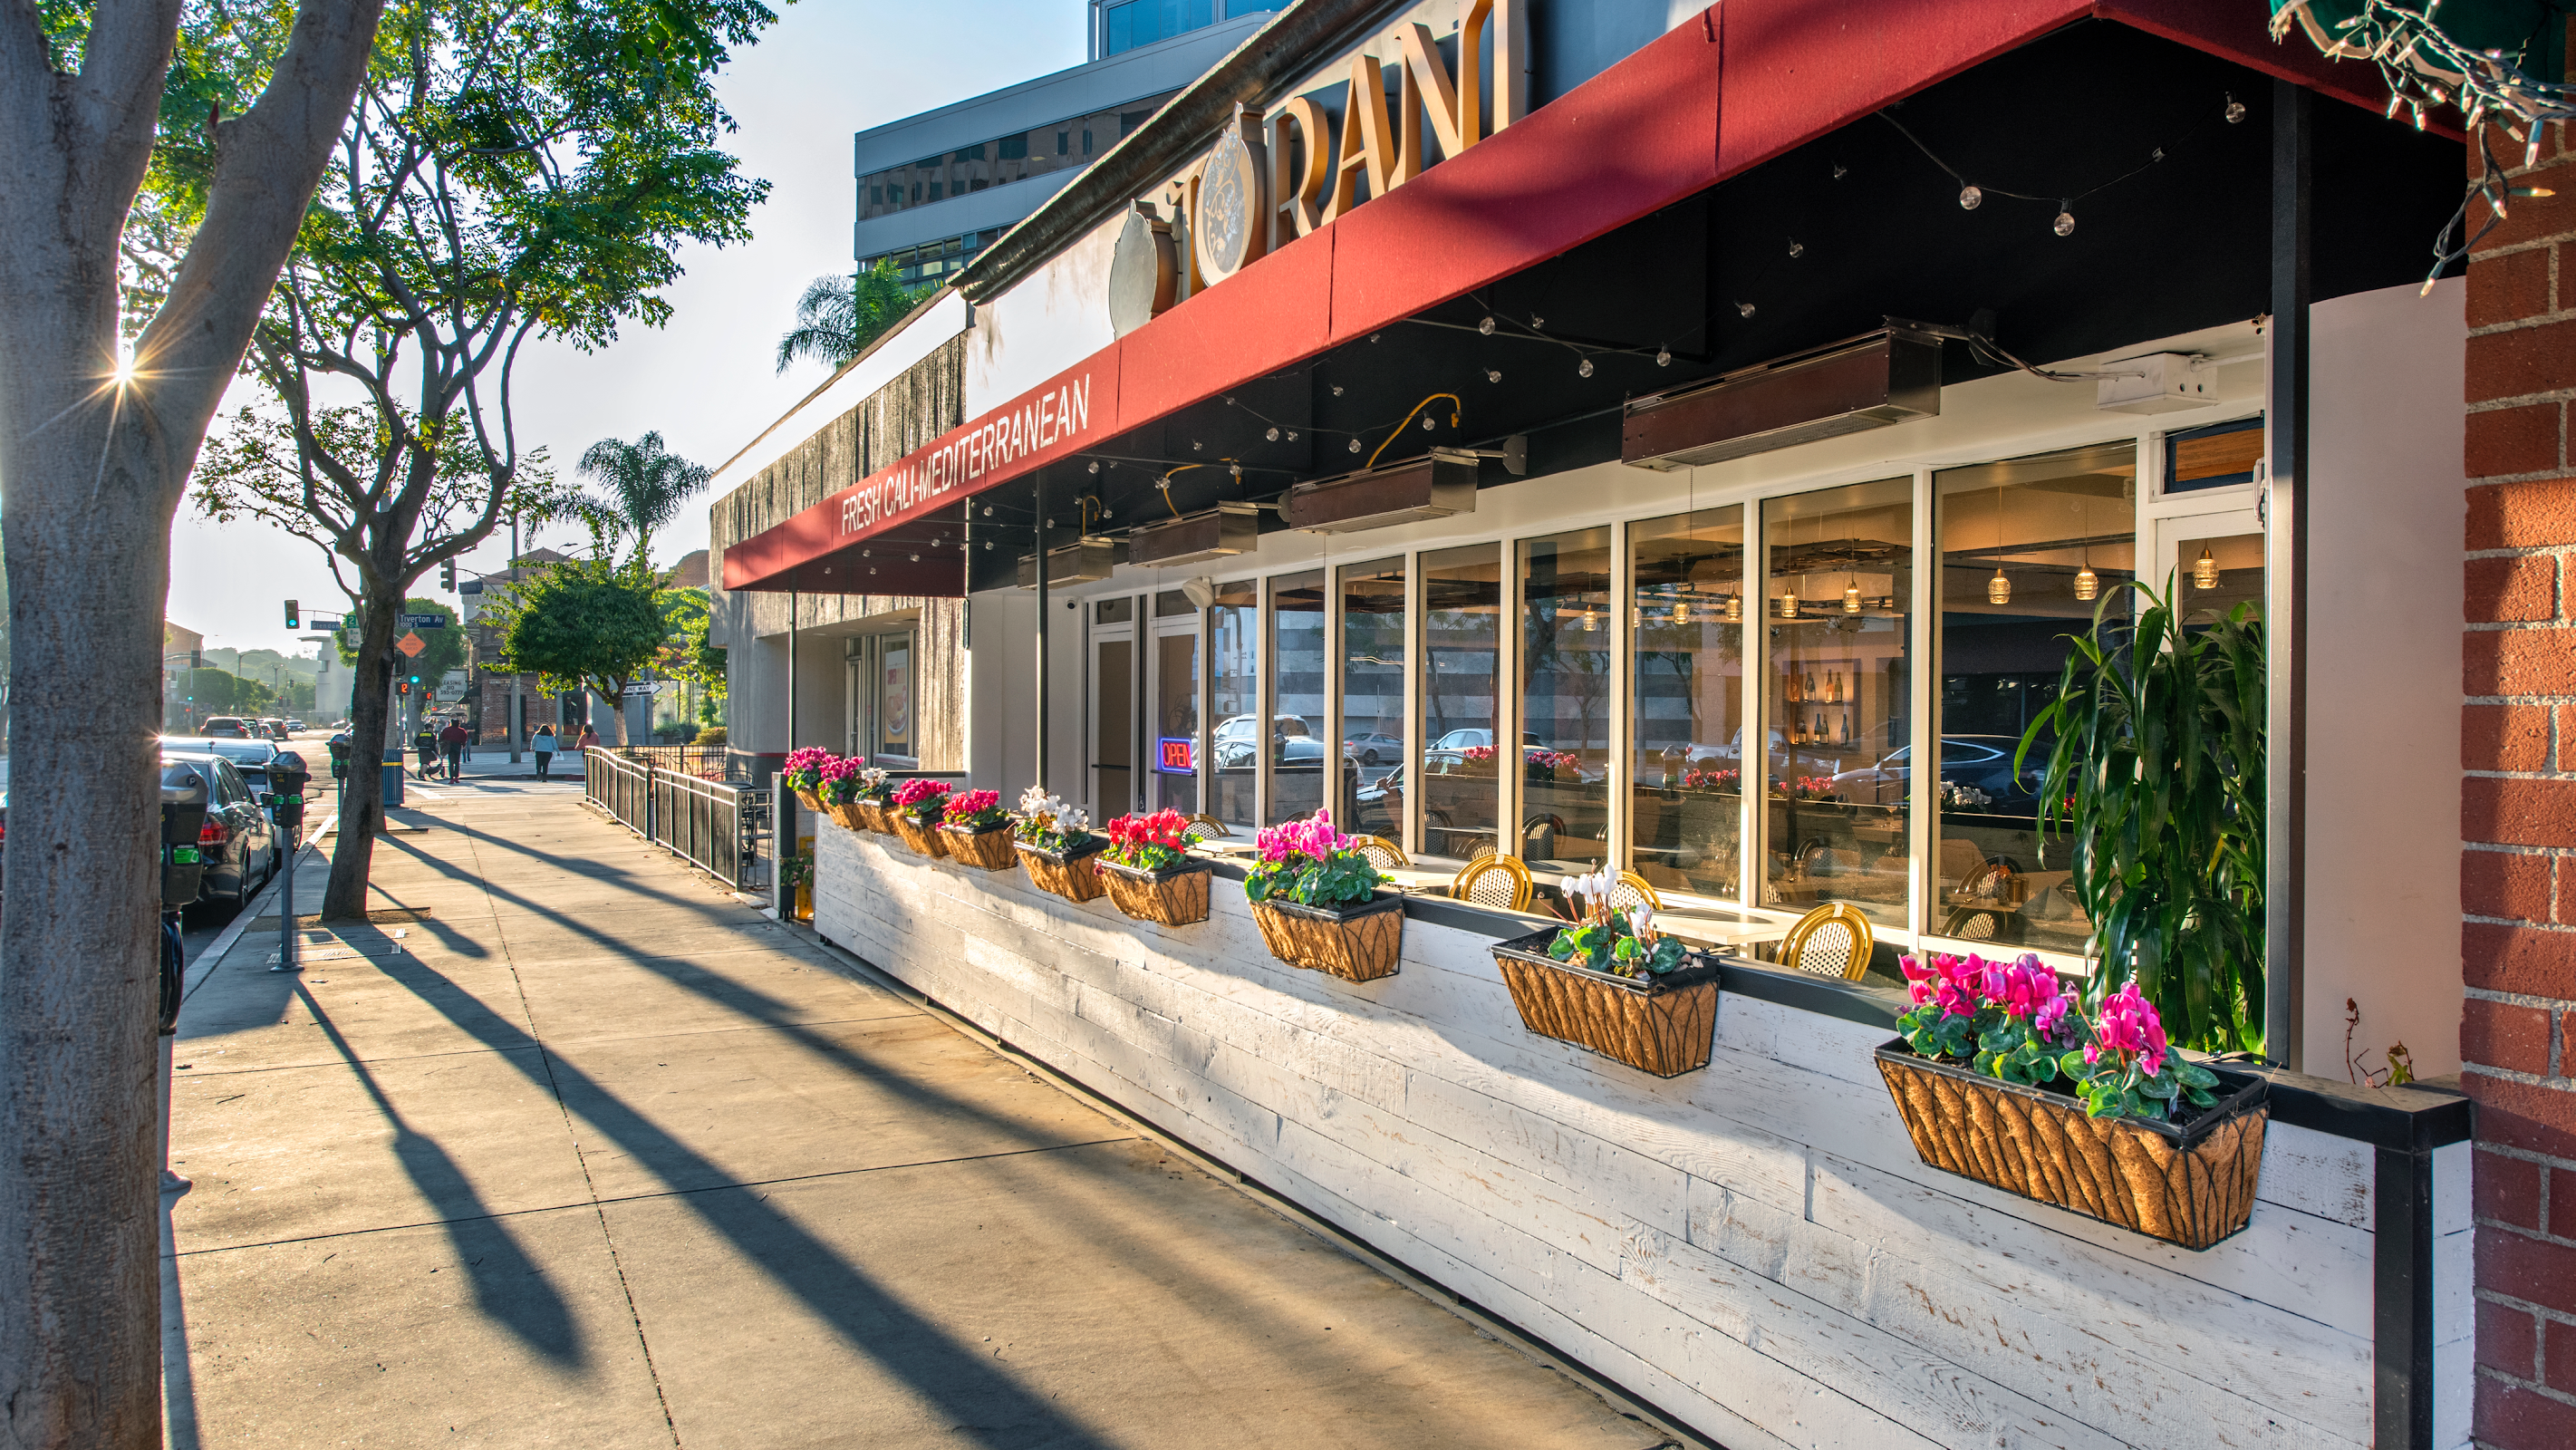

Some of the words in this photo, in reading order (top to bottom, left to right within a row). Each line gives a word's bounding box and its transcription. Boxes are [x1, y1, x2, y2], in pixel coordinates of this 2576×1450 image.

[842, 482, 882, 536] FRESH
[884, 373, 1091, 517] CALI-MEDITERRANEAN
[400, 614, 431, 624] Tiverton
[434, 615, 444, 624] Av
[1163, 742, 1192, 768] OPEN
